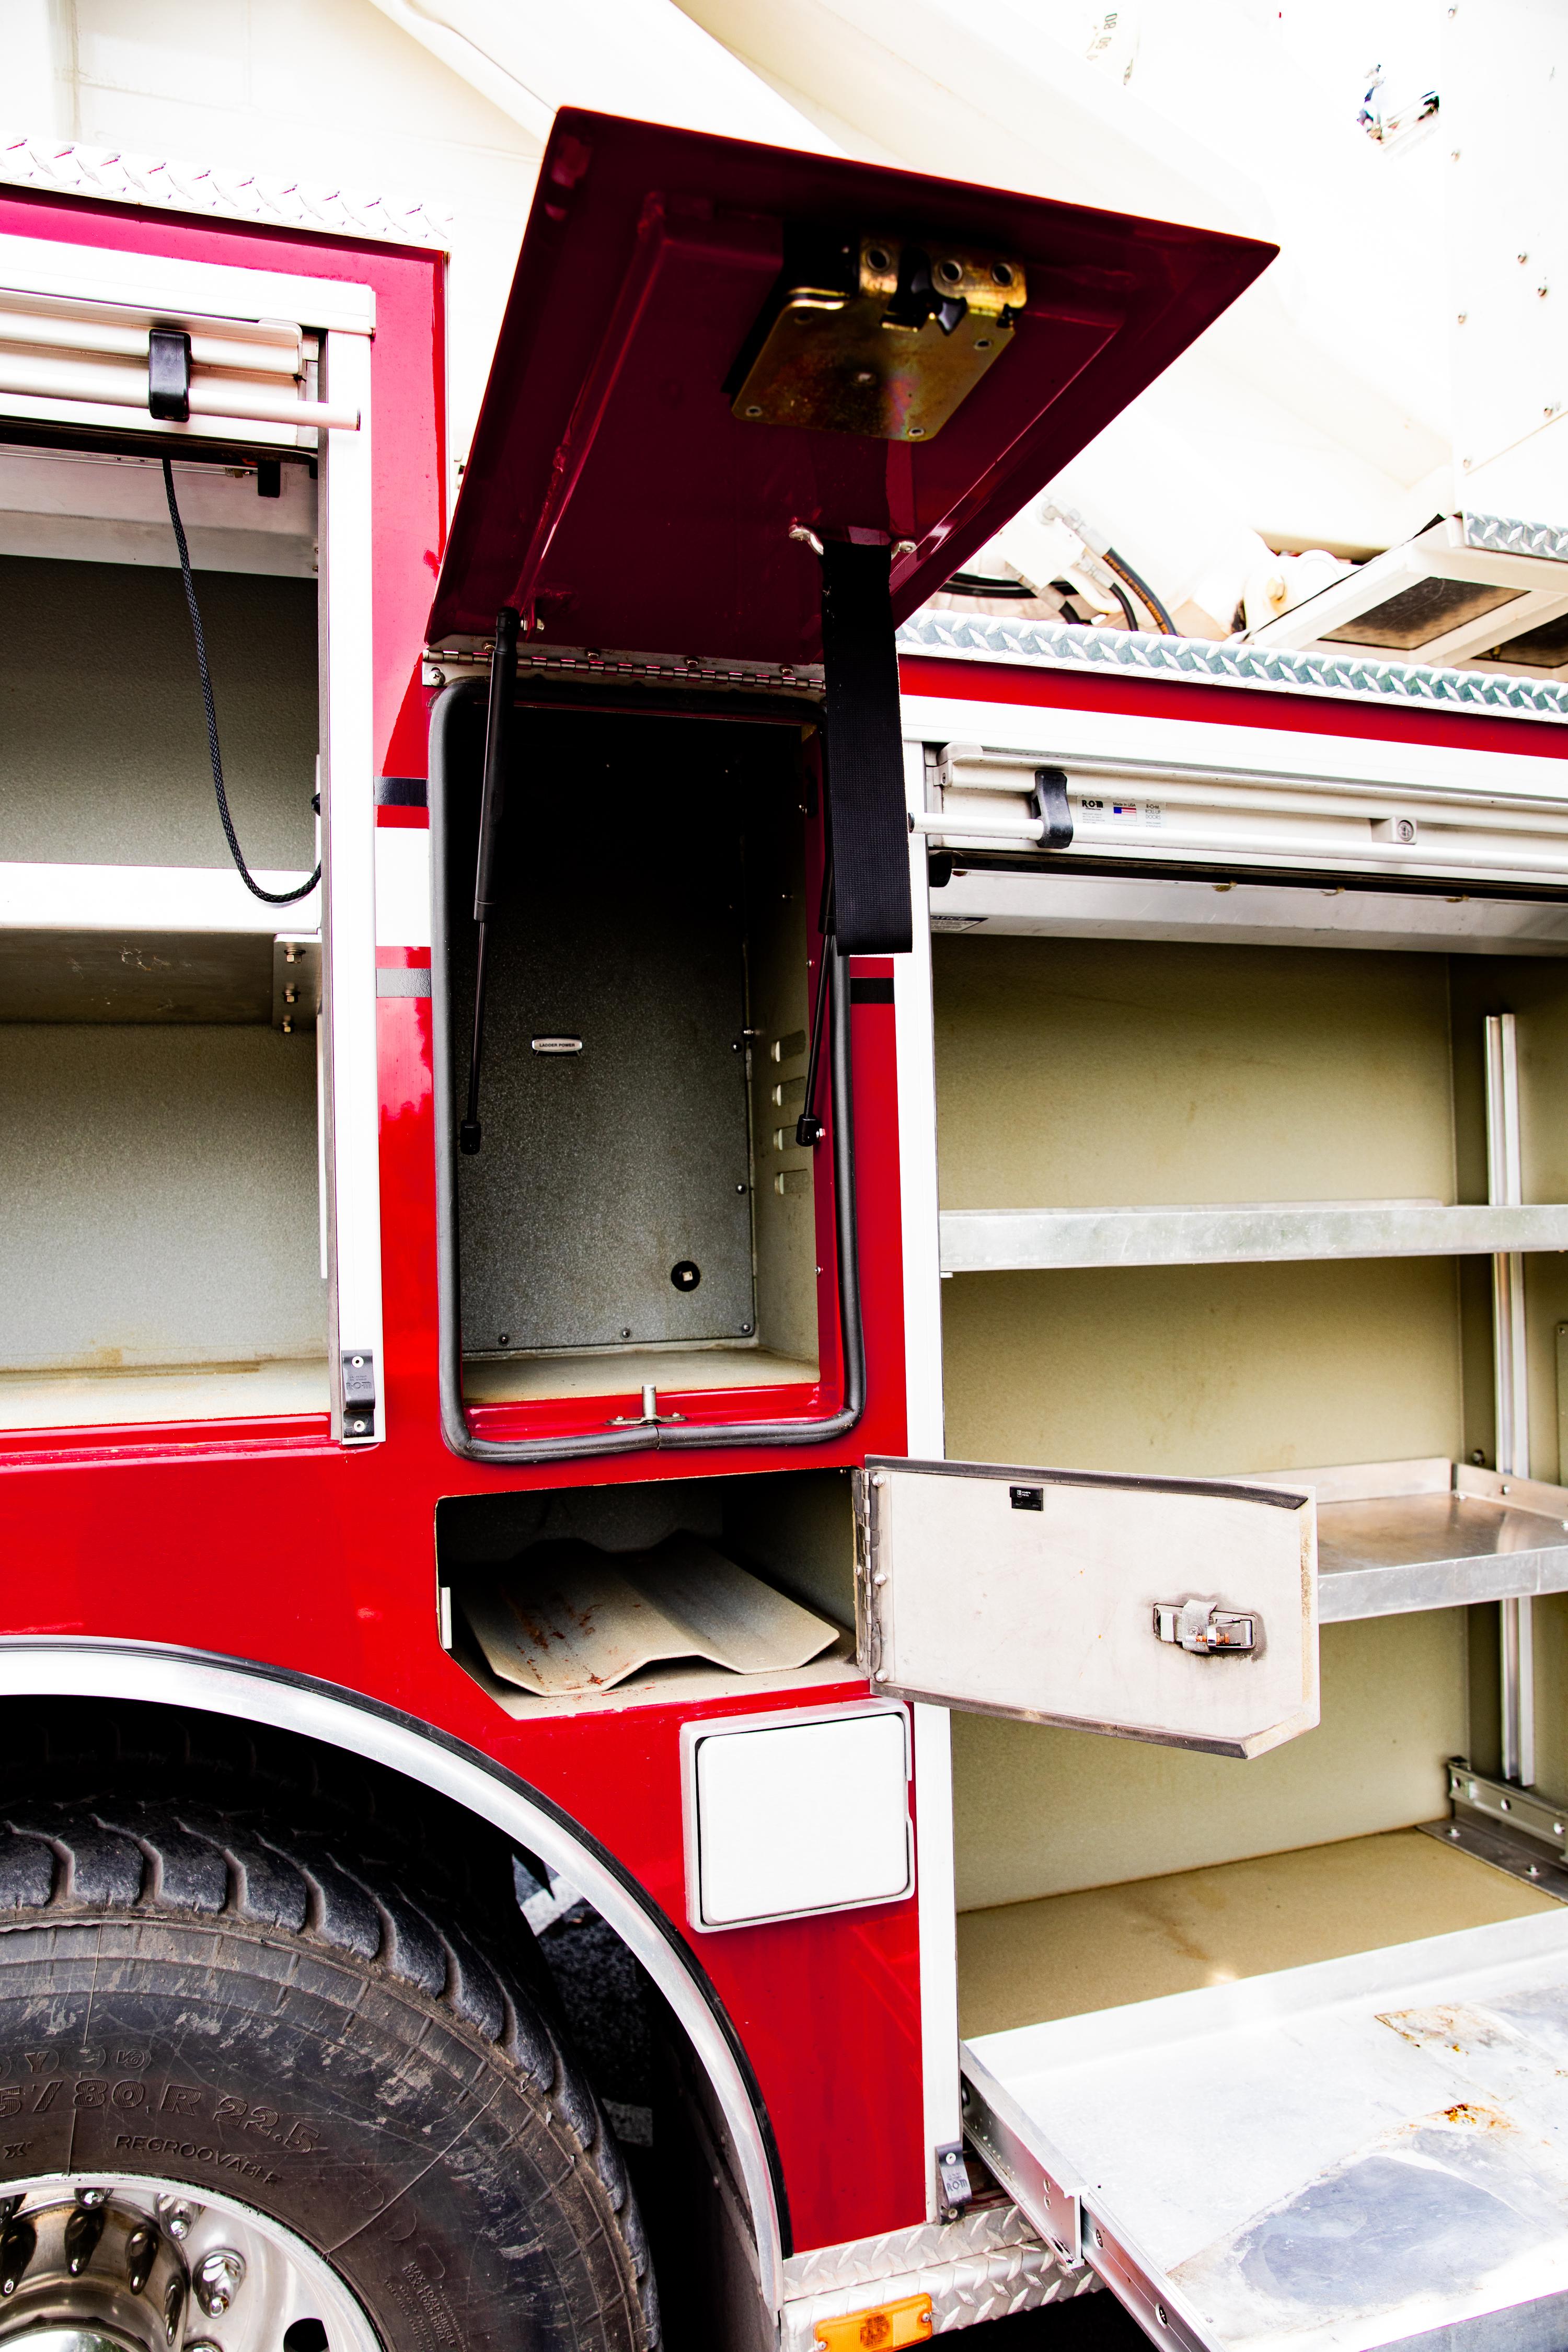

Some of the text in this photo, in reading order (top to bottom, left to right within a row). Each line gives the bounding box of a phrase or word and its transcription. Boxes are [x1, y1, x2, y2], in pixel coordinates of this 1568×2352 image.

[160, 2084, 202, 2116] R
[213, 2096, 321, 2154] 22.5
[115, 2135, 282, 2187] REGROOVABLE
[417, 2289, 434, 2315] LOAD
[431, 2316, 446, 2343] DUAL
[424, 2285, 441, 2310] LOAD
[437, 2312, 457, 2347] SINGLE
